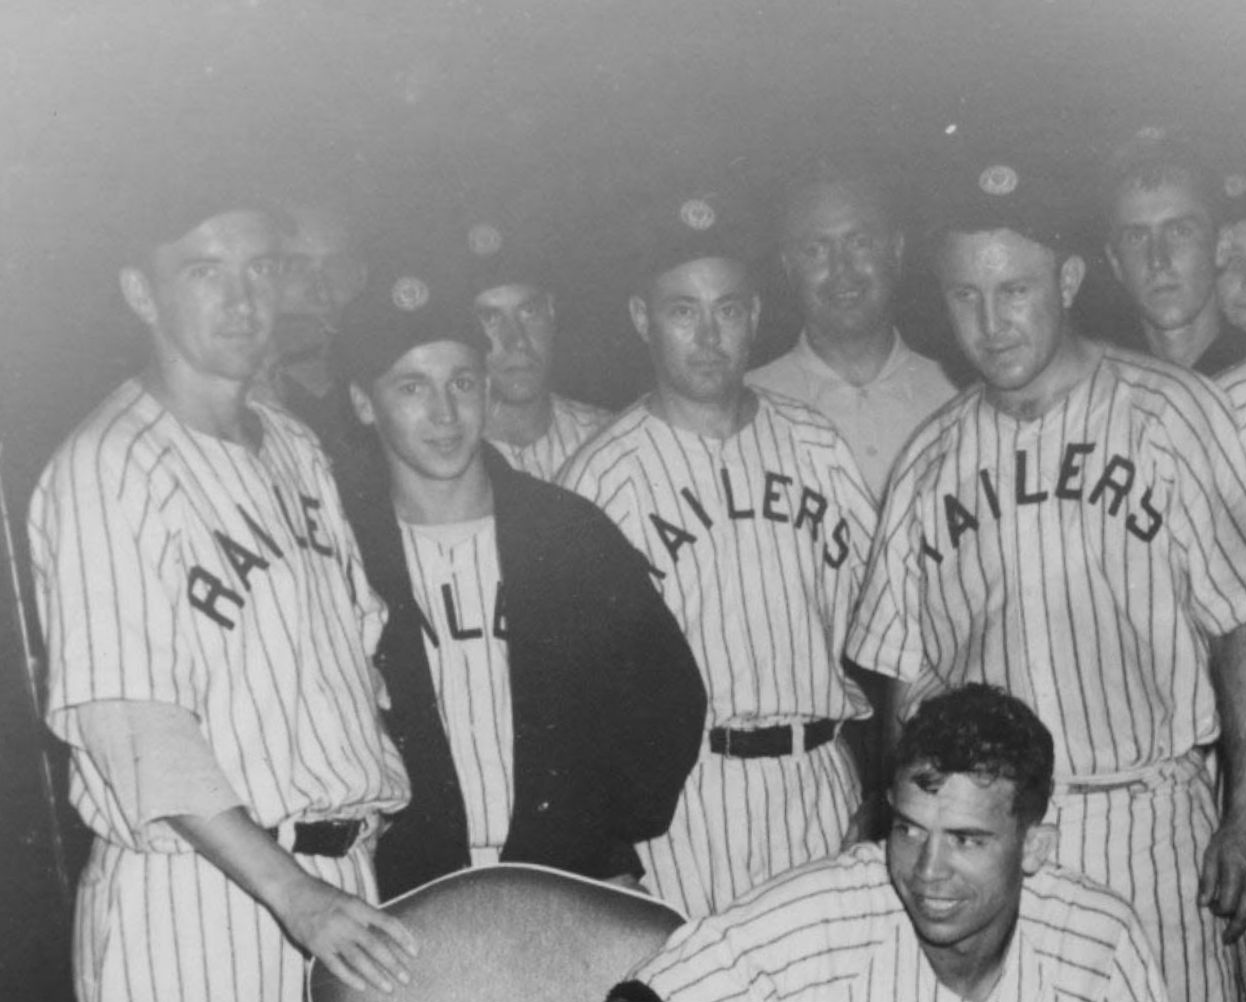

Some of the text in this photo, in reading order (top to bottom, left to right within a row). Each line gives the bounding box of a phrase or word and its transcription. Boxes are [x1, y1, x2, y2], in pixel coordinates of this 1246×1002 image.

[187, 484, 356, 631] RAILE
[648, 468, 850, 570] AILERS
[919, 443, 1163, 564] AILERS
